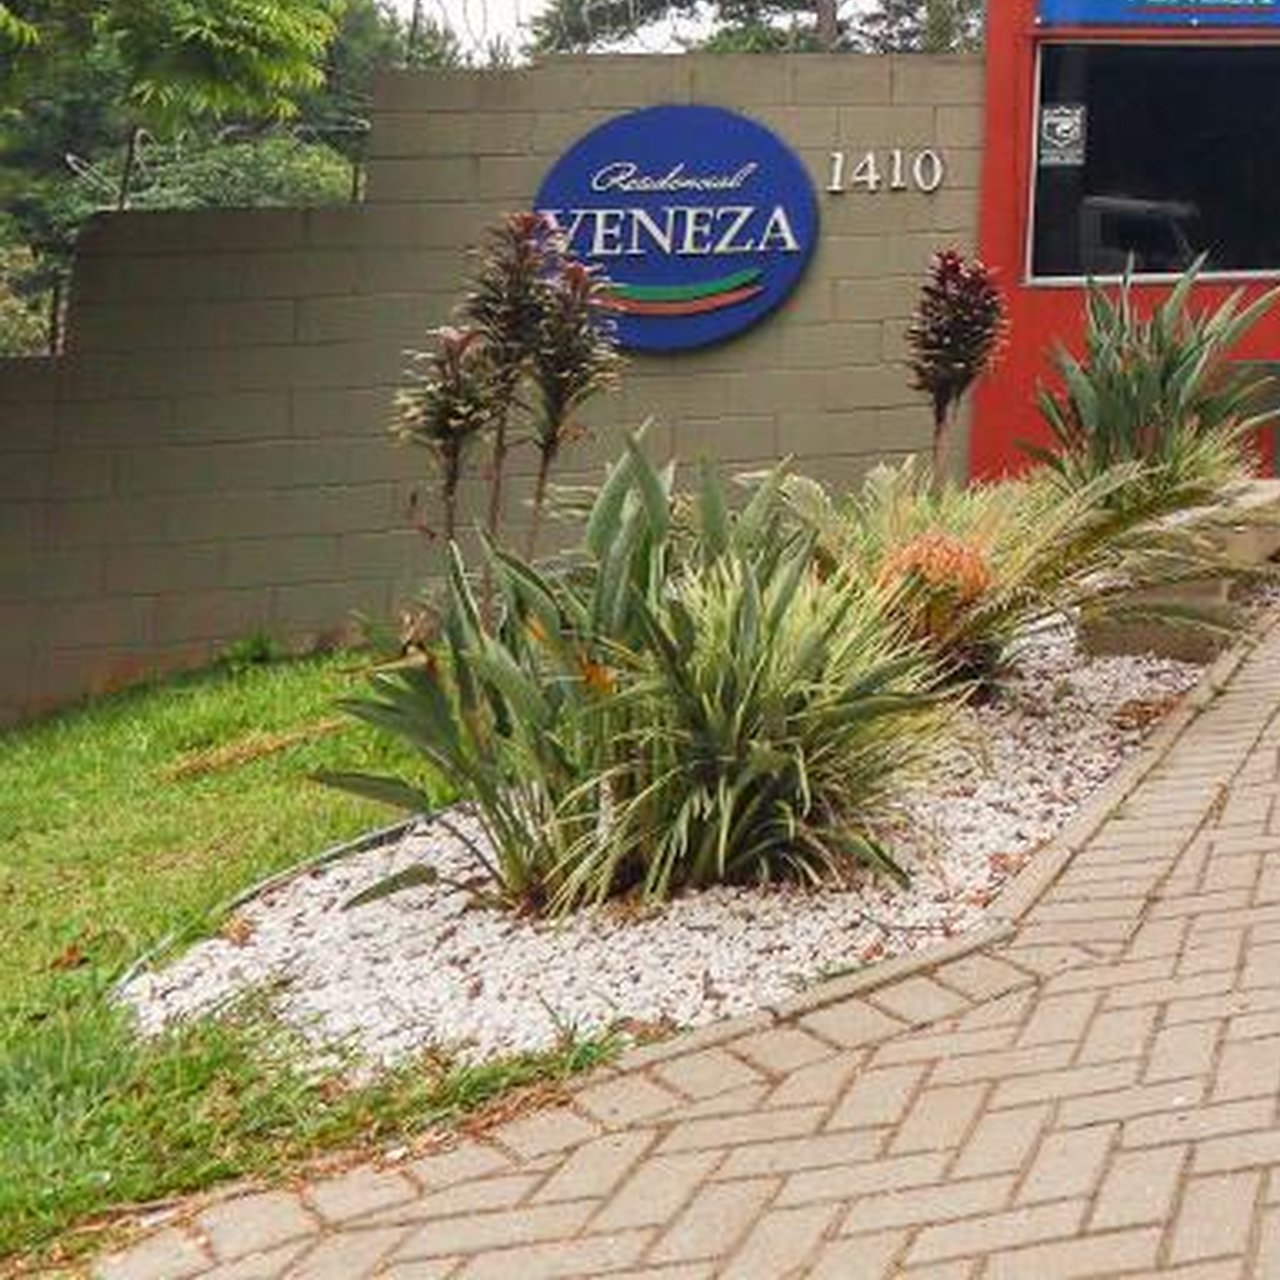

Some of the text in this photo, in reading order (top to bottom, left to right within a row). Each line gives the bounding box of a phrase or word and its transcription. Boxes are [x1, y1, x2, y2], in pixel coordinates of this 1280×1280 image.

[591, 161, 758, 191] Residencial
[826, 148, 943, 192] 1410
[537, 204, 800, 255] VENEZA
